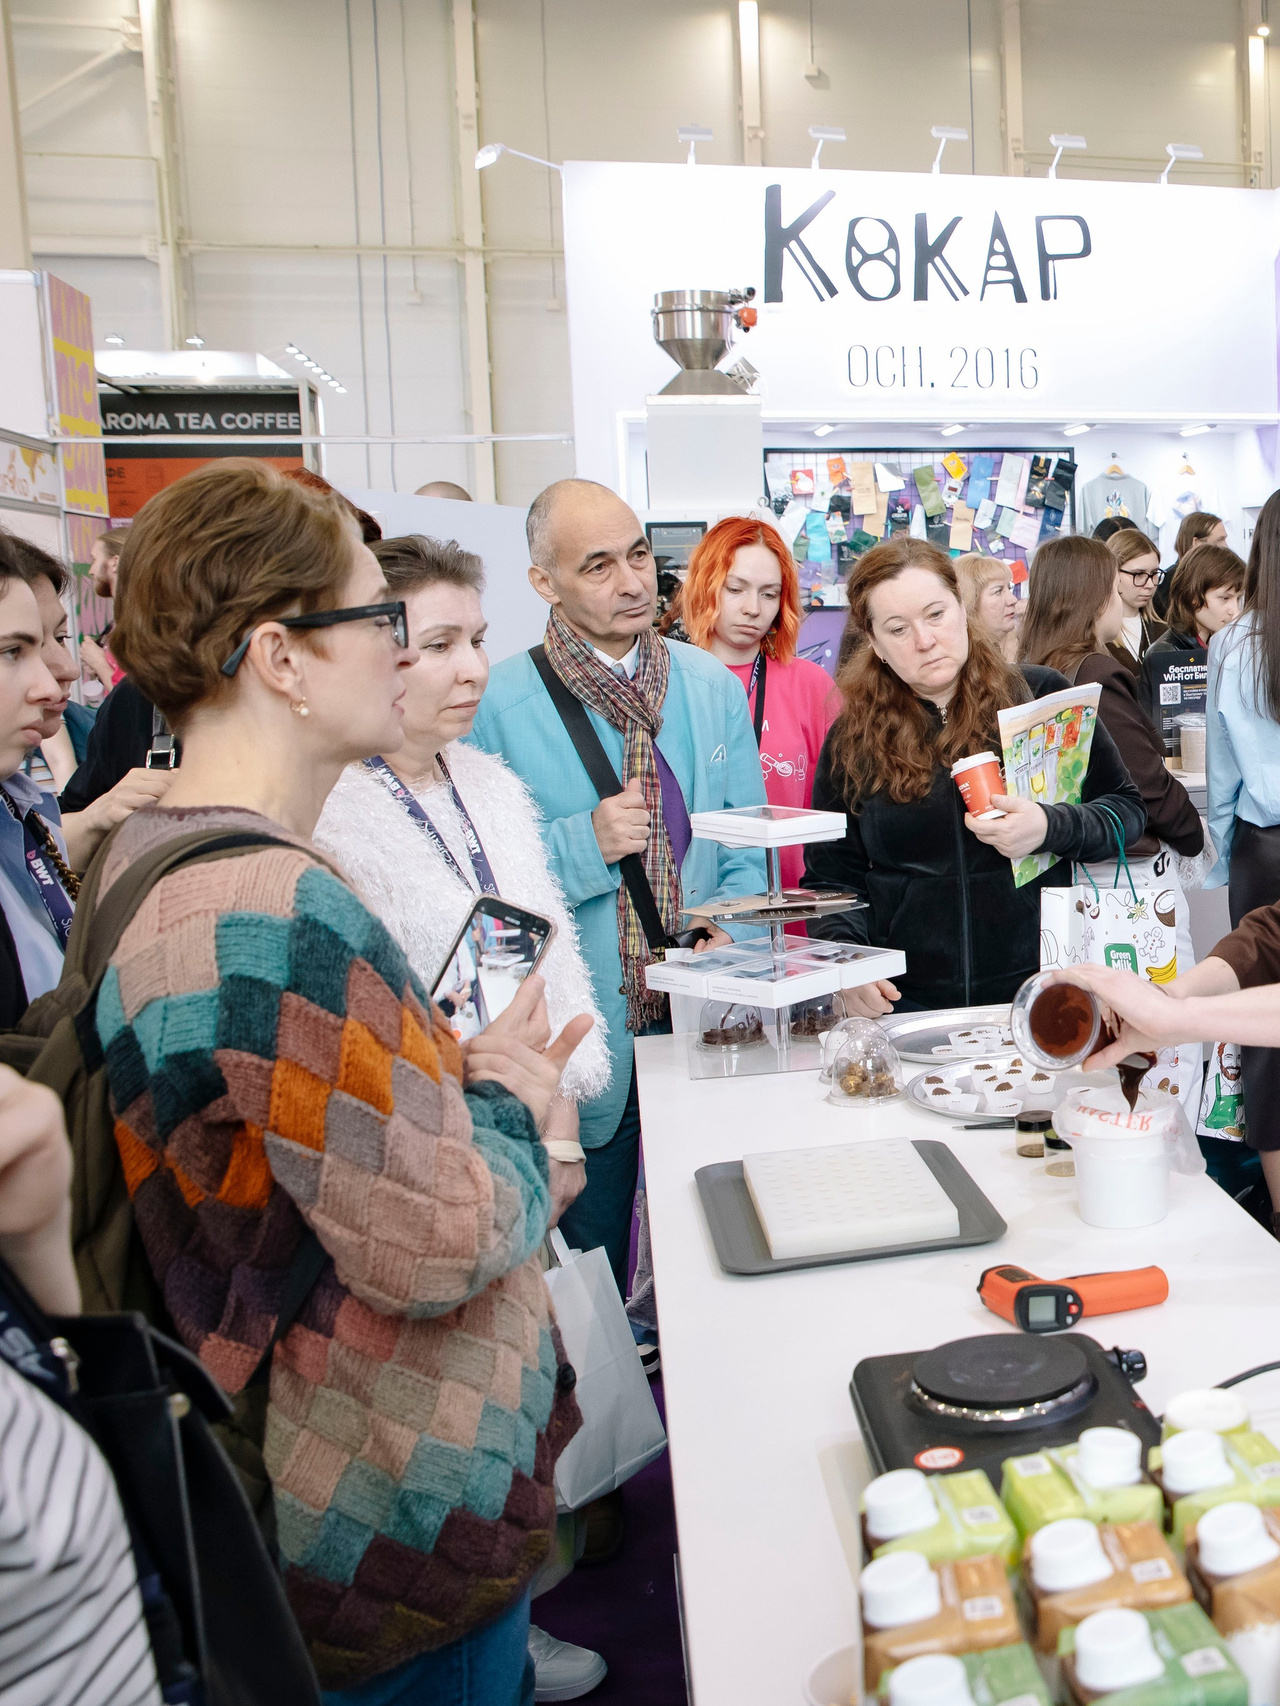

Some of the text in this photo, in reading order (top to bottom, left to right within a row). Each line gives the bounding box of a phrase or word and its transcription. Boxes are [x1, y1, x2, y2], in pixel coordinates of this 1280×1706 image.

[764, 184, 1092, 303] КОКАР
[847, 344, 1039, 390] ОСН. 2016
[174, 412, 217, 430] TEA
[220, 412, 300, 430] COFFEE
[376, 767, 401, 792] BWT
[30, 857, 54, 886] BWT
[1110, 950, 1132, 961] Green
